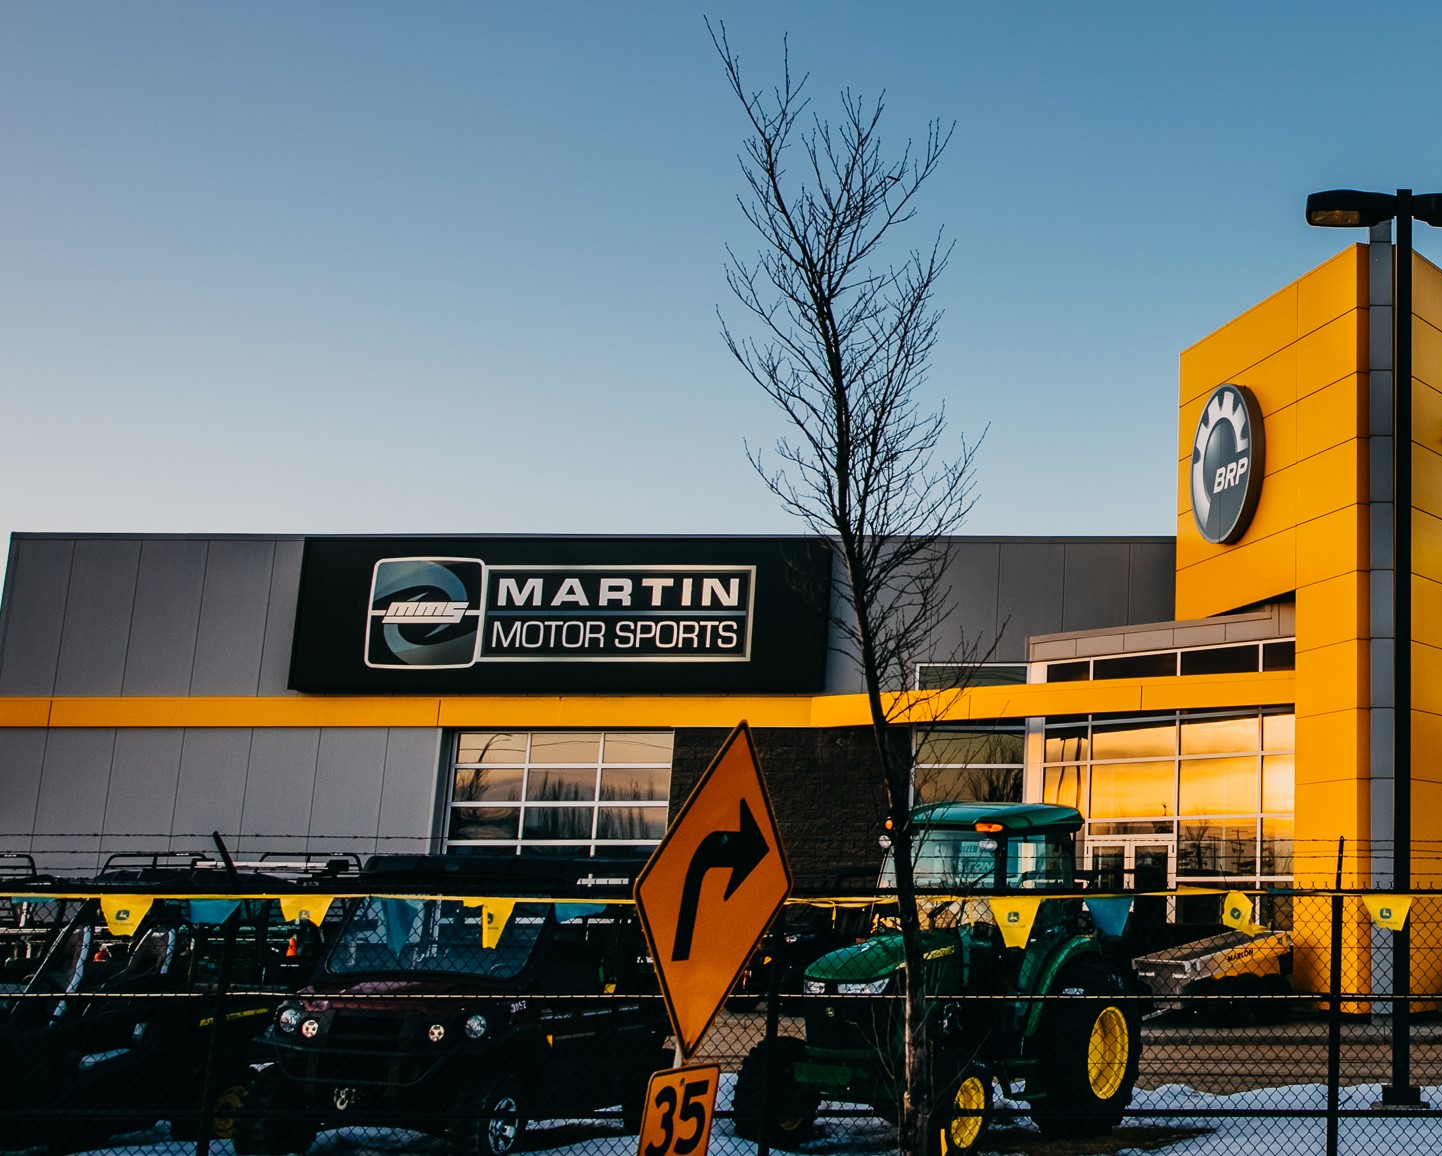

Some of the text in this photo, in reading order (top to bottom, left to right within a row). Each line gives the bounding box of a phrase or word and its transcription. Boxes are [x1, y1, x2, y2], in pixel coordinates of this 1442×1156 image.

[1213, 456, 1249, 494] BRP
[497, 578, 740, 607] MARTIN
[491, 620, 739, 649] MOTOR SPORTS
[645, 1079, 710, 1156] 35
